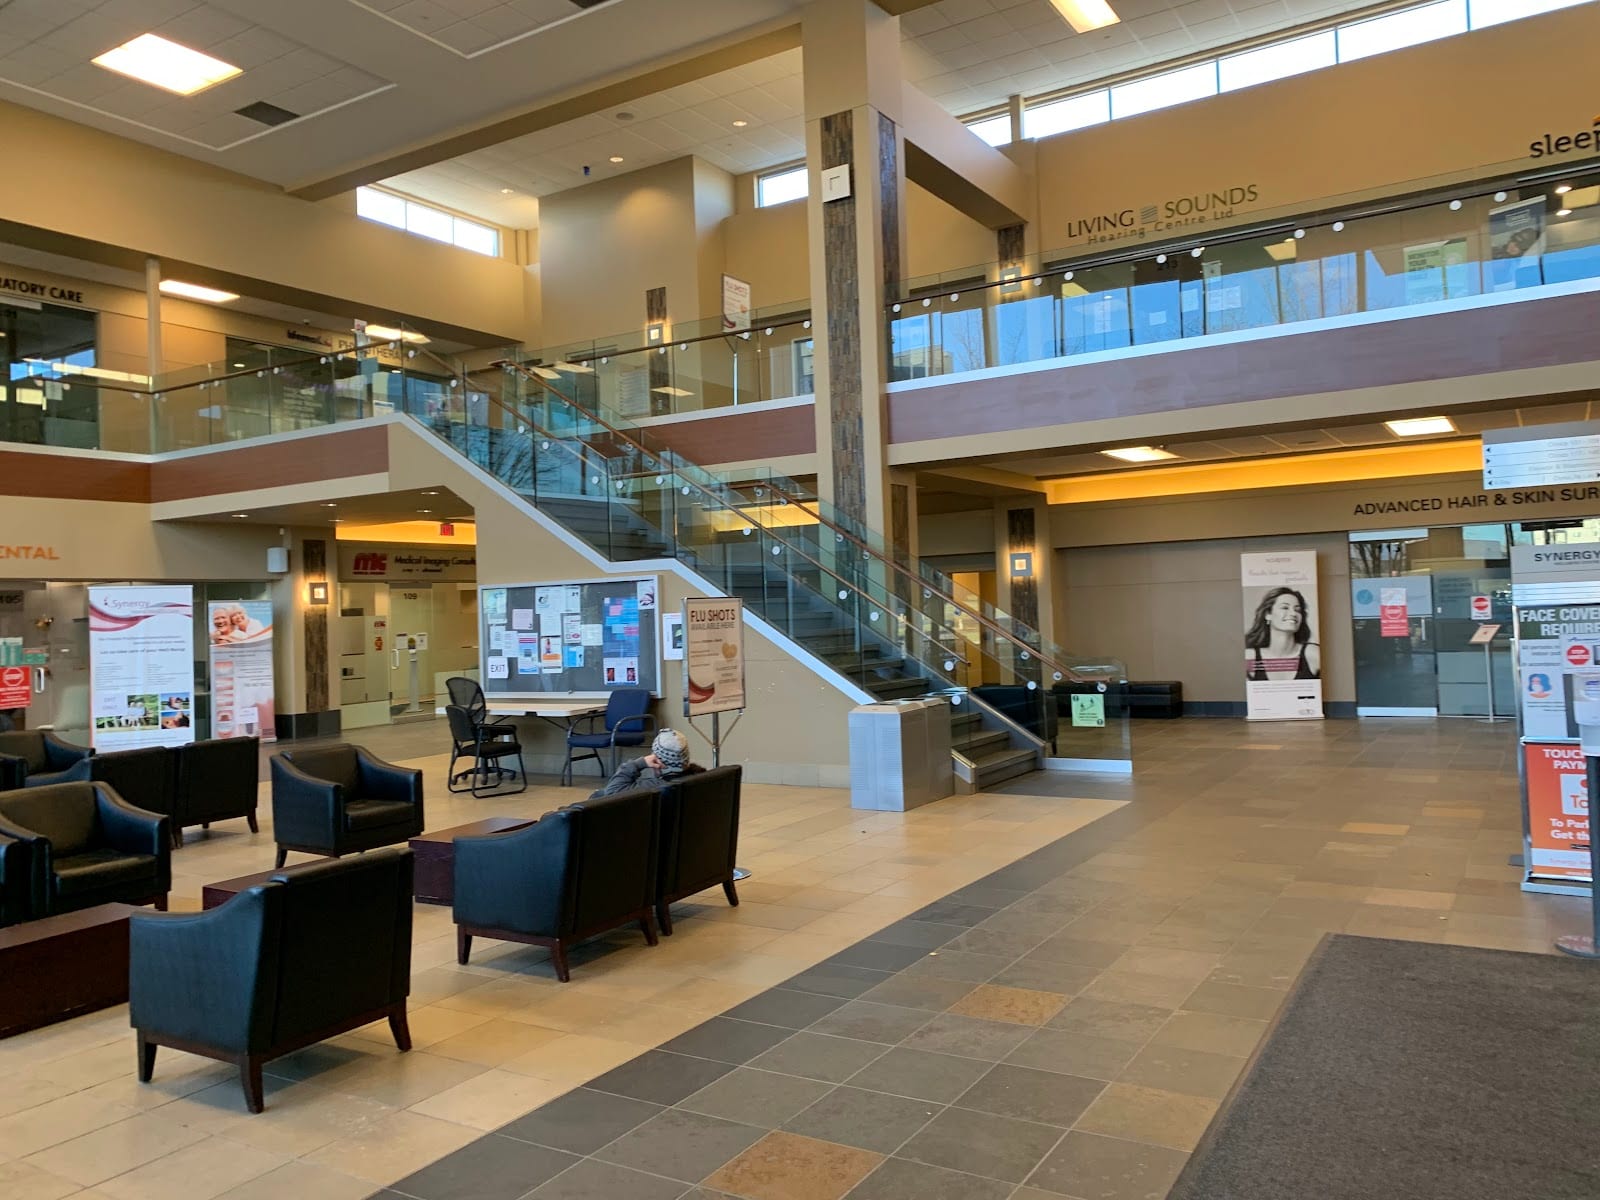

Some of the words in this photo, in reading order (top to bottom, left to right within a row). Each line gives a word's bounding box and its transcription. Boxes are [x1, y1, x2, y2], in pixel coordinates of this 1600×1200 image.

[1068, 210, 1134, 238] LIVING
[1164, 184, 1258, 219] SOUNDS
[1087, 227, 1146, 246] Hearing
[1154, 215, 1209, 233] Centre
[1213, 208, 1235, 221] Ltd
[49, 286, 84, 303] CARE
[1353, 497, 1442, 516] ADVANCED
[1447, 494, 1488, 509] HAIR
[1494, 493, 1507, 506] &
[1512, 489, 1555, 505] SKIN
[394, 554, 421, 564] Medical
[1534, 551, 1600, 563] SYNERGY
[690, 610, 706, 622] FLU
[708, 608, 736, 621] SHOTS
[1519, 609, 1556, 623] FACE
[490, 663, 505, 673] EXIT
[1550, 818, 1564, 827] To
[1551, 830, 1574, 840] Get
